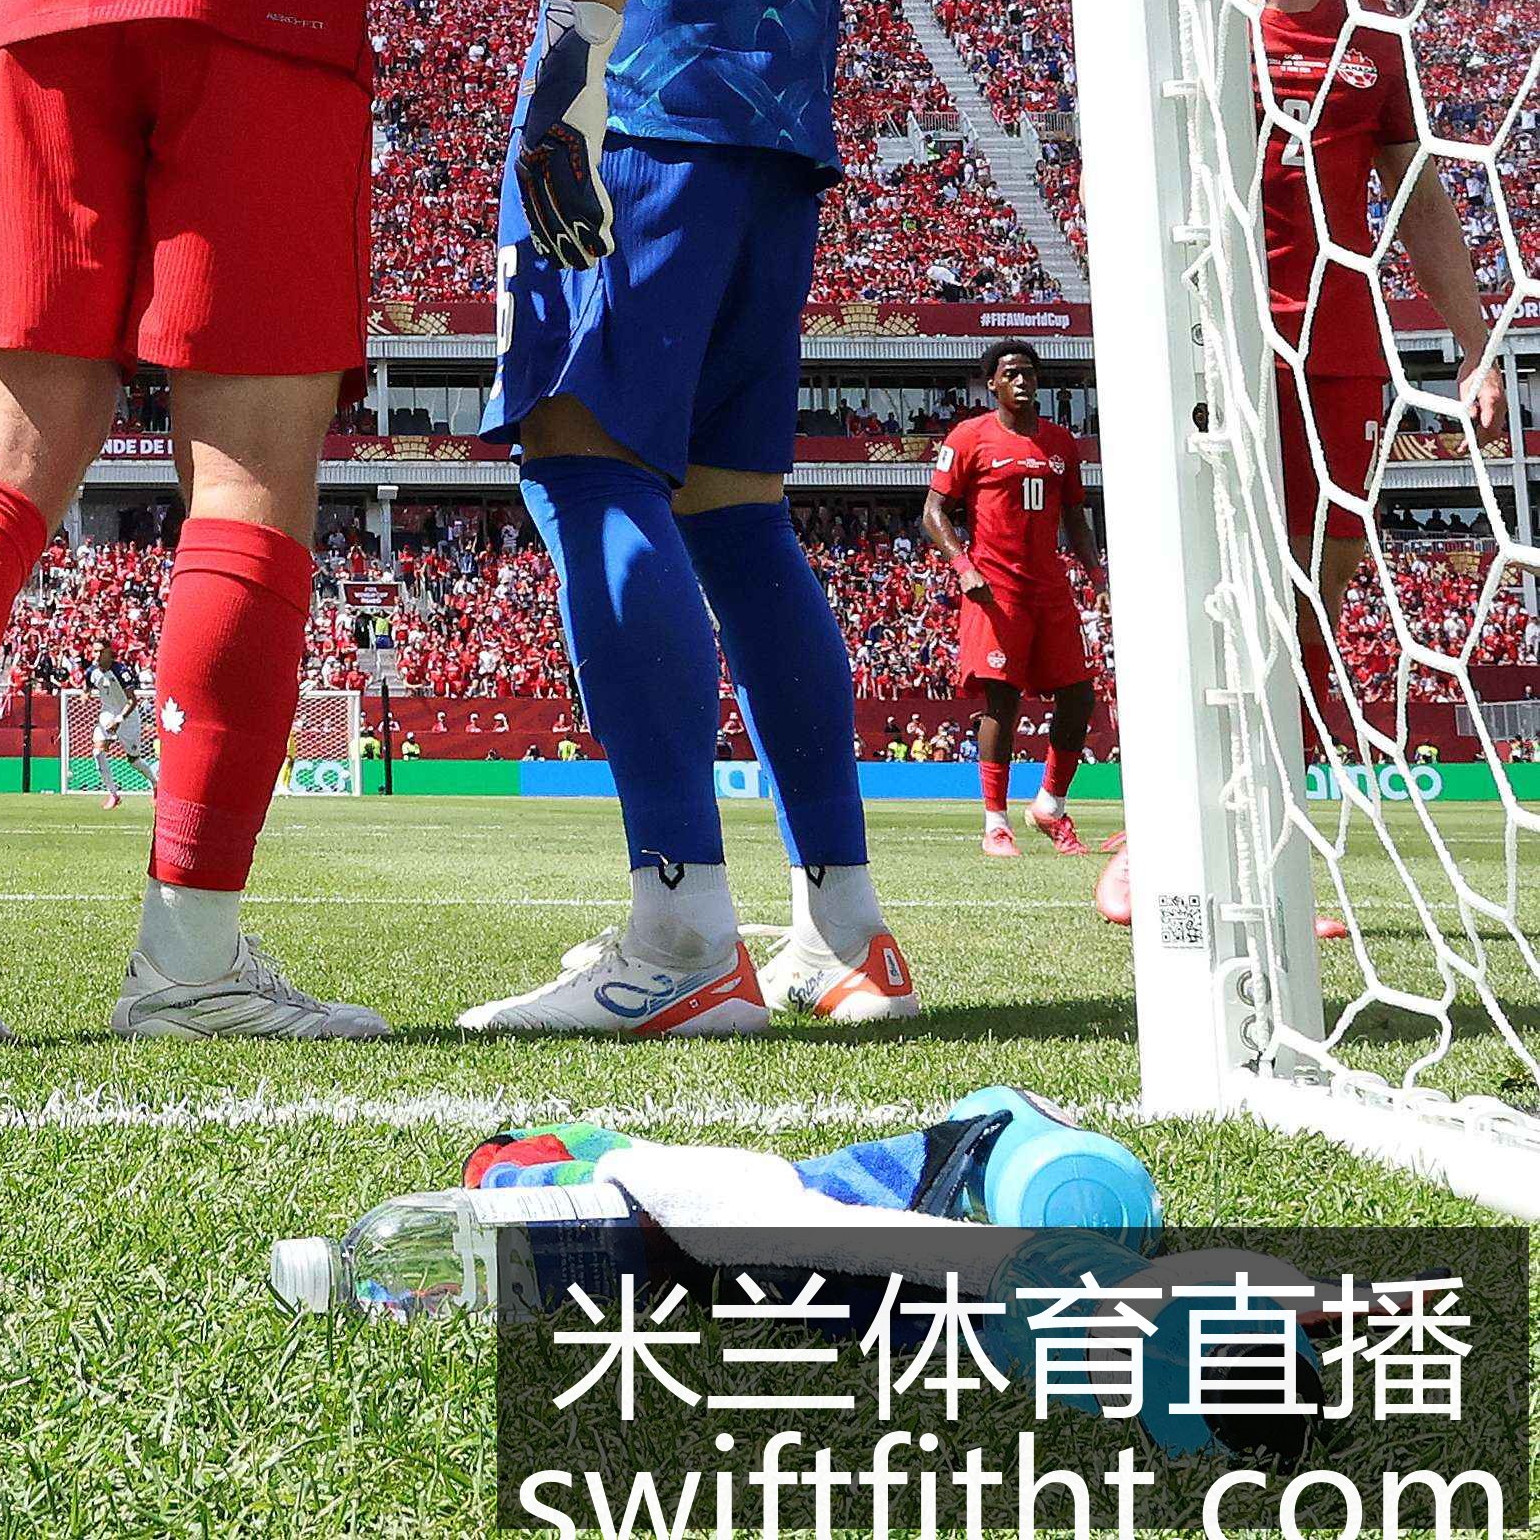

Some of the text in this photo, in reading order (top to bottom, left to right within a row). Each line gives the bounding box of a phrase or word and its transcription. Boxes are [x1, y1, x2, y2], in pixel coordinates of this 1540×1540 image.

[980, 312, 1070, 329] #FIFAWorldCup
[101, 439, 137, 454] NDE
[140, 439, 164, 454] DE
[1022, 476, 1043, 510] 10
